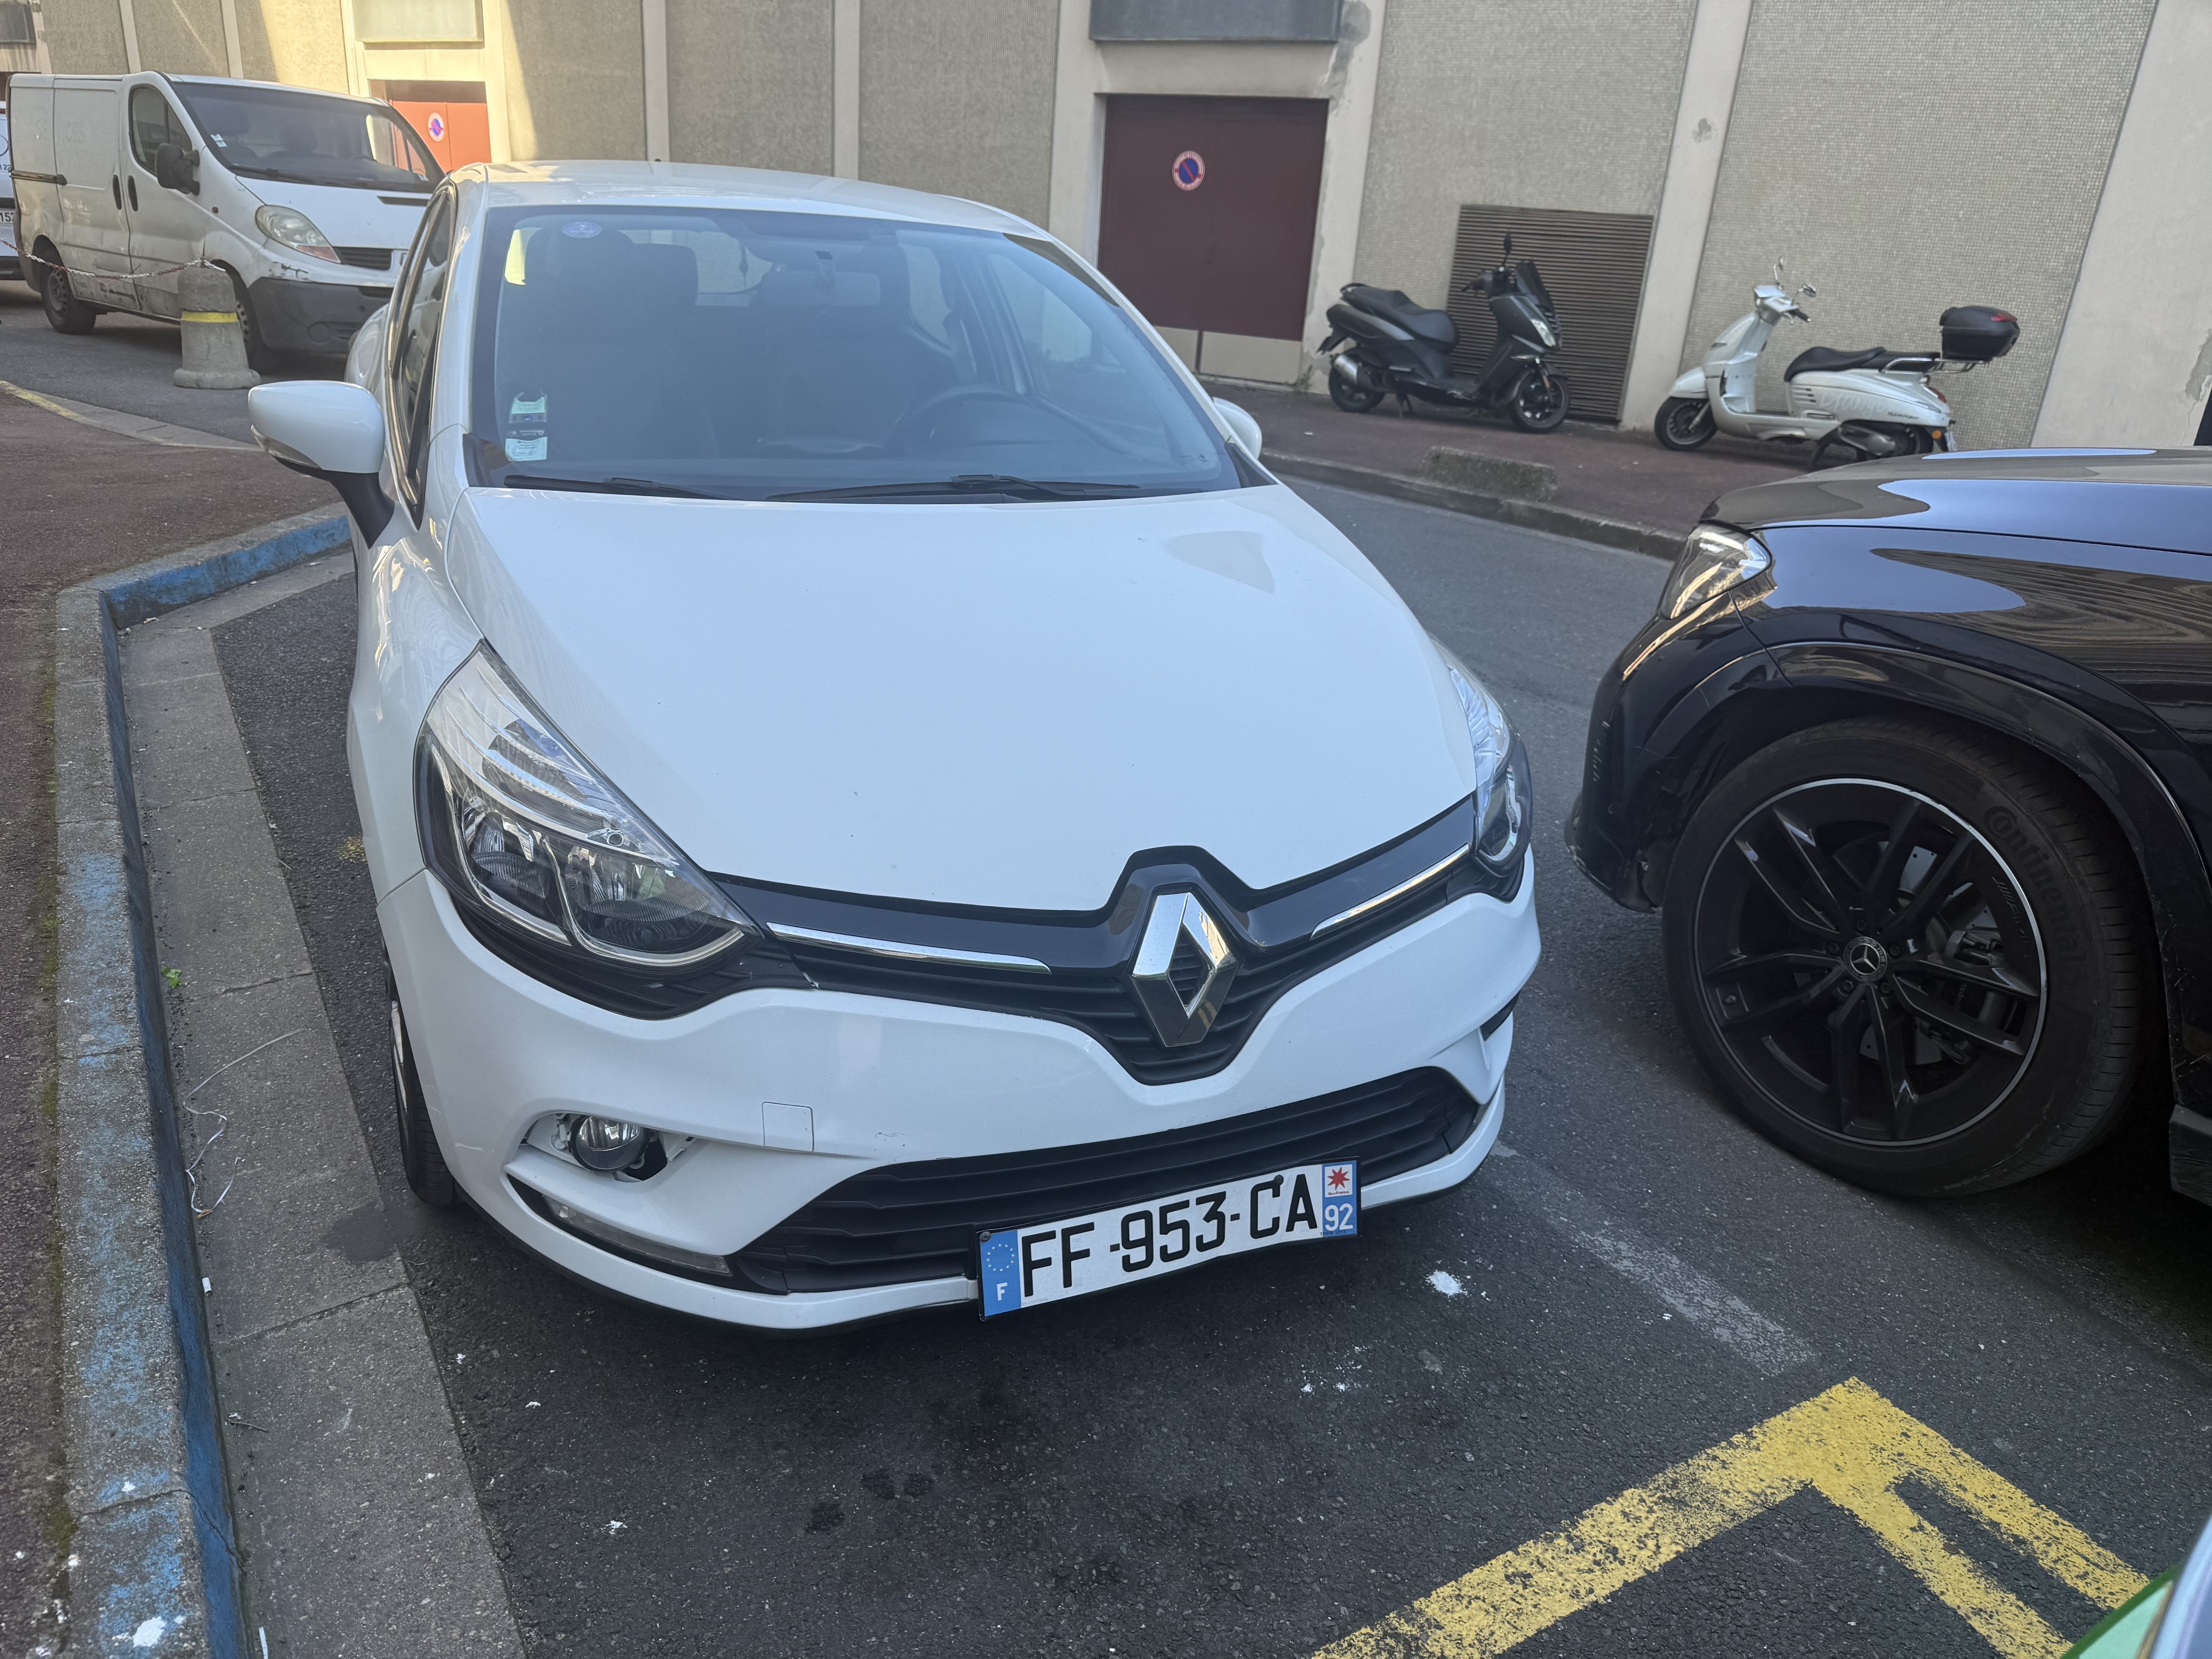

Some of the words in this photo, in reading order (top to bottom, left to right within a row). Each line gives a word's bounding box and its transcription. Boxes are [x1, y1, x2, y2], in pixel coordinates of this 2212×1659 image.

[1983, 806, 2087, 963] Continental
[1325, 1203, 1353, 1231] 92
[996, 1282, 1008, 1301] F
